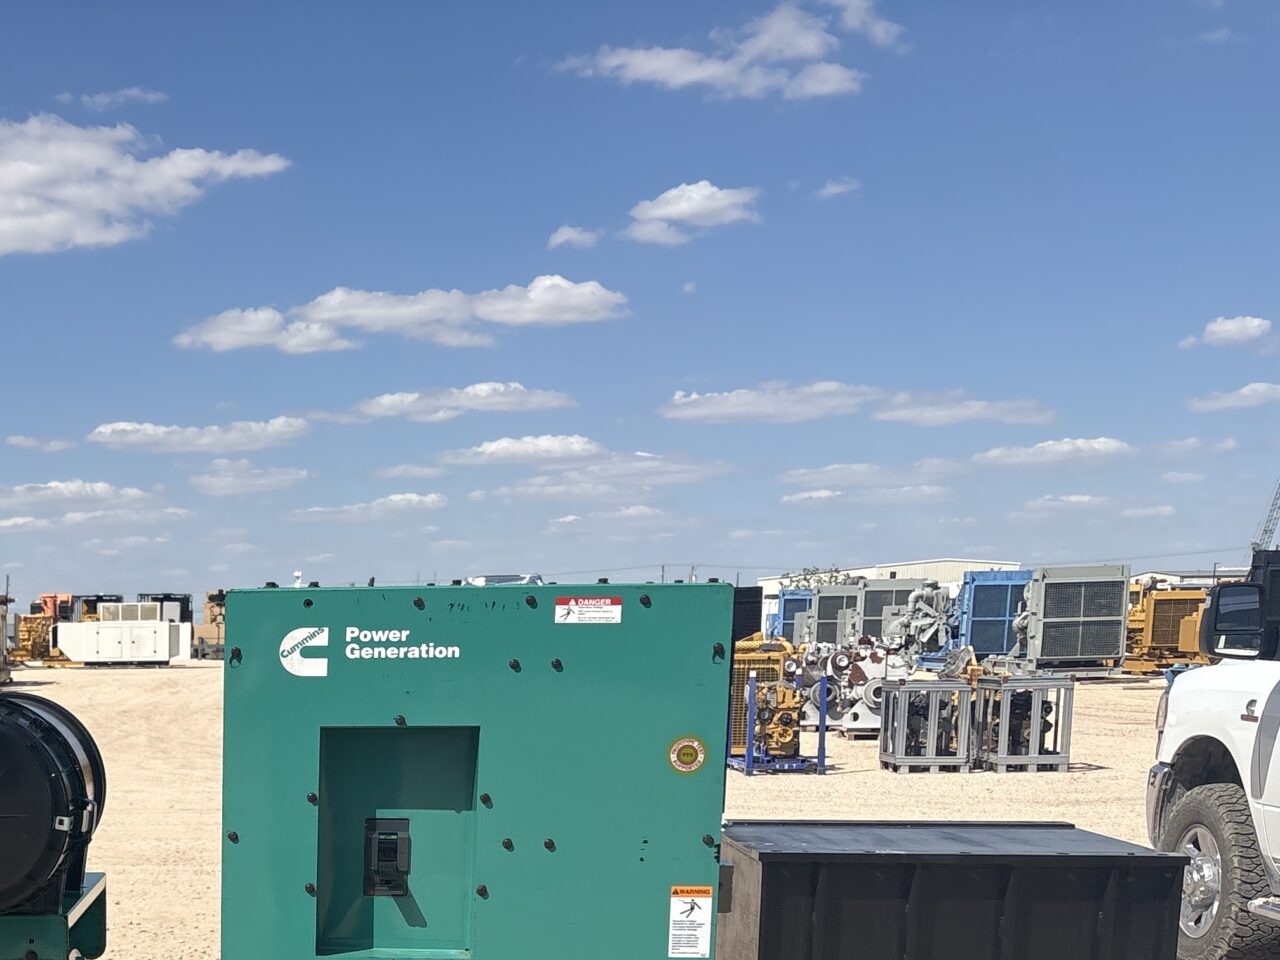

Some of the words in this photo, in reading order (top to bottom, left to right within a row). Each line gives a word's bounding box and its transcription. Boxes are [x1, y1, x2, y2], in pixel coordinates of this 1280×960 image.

[577, 598, 612, 606] DANGER
[345, 626, 410, 642] Power
[280, 626, 325, 660] Cummins
[345, 642, 460, 659] Generation
